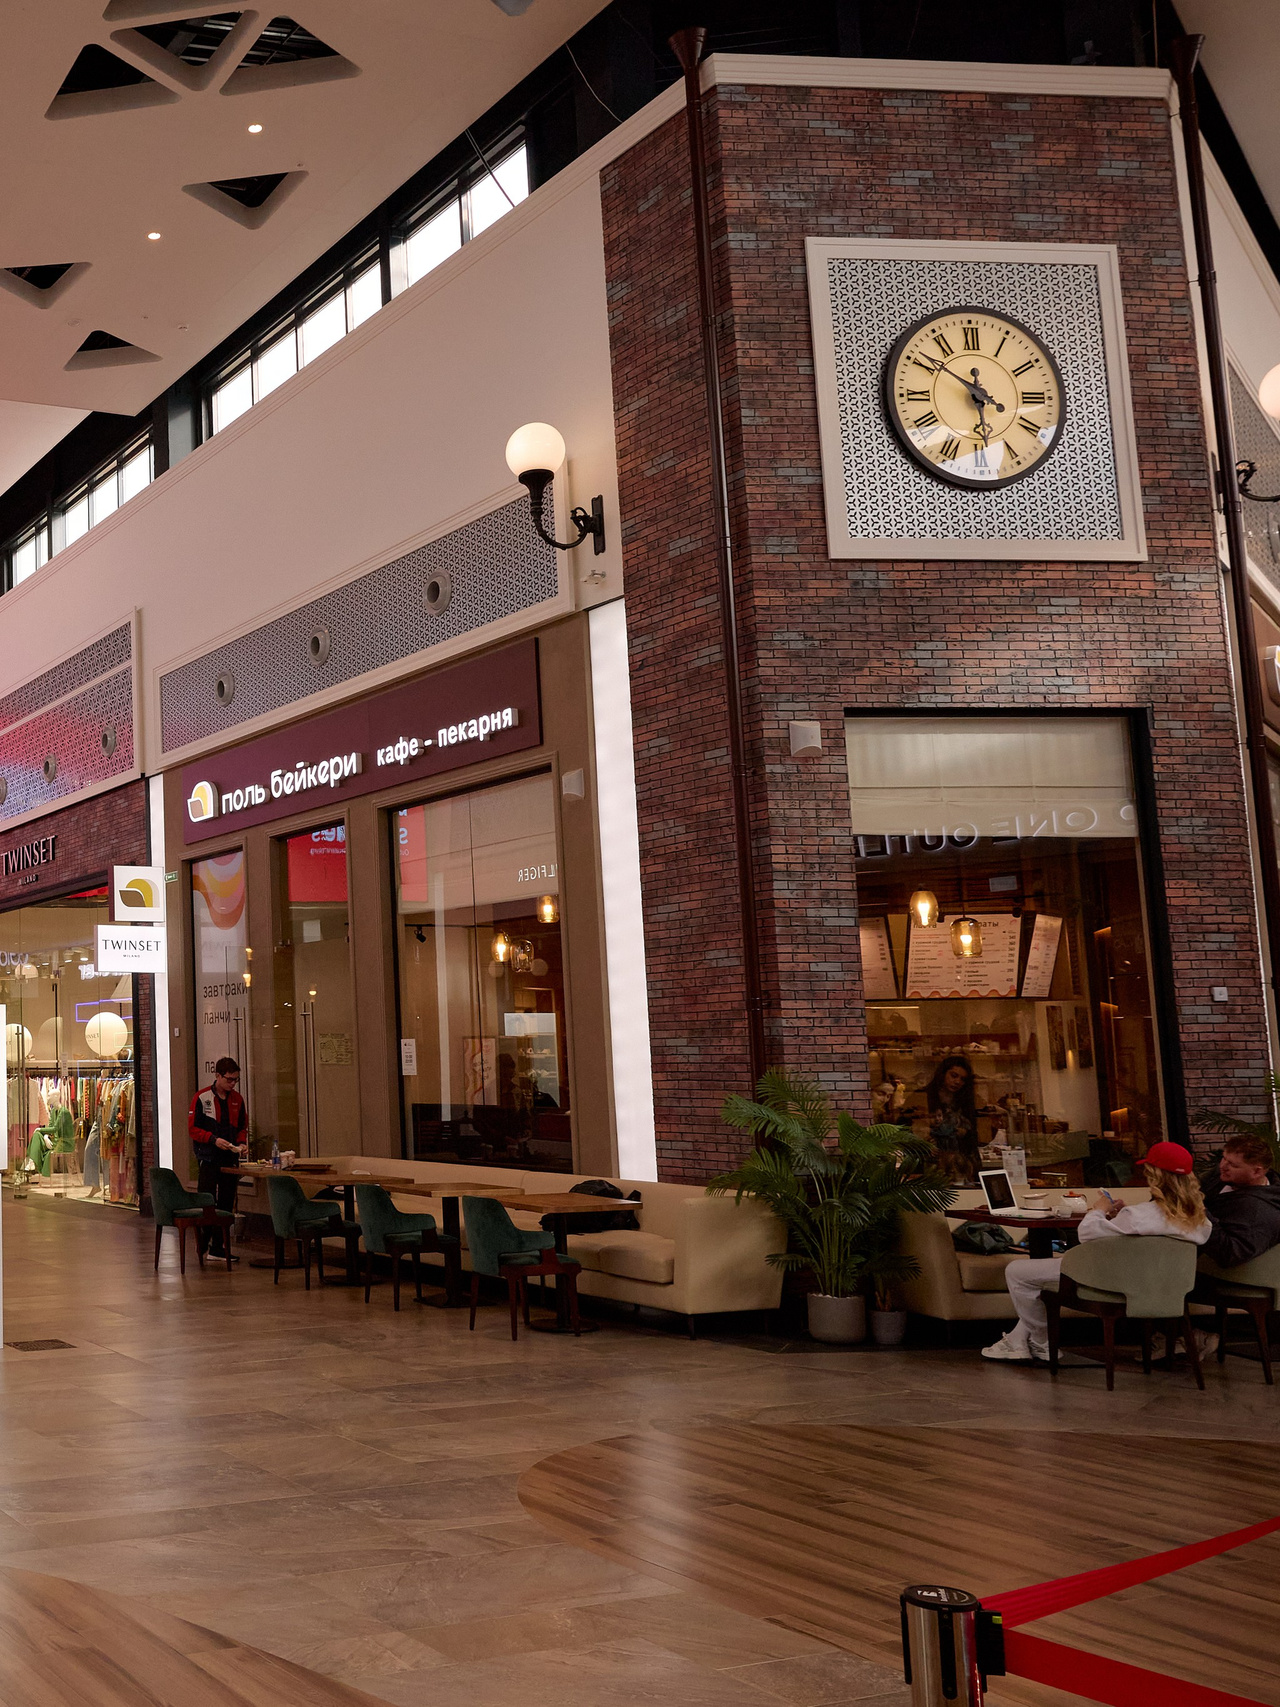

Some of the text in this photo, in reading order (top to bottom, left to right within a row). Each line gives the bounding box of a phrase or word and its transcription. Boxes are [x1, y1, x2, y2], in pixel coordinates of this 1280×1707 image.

[933, 333, 955, 358] XI
[962, 327, 981, 351] XII
[1012, 360, 1035, 377] II
[907, 389, 931, 402] IX
[1022, 391, 1045, 404] III
[376, 736, 421, 768] кафе
[436, 706, 517, 749] пекарня
[221, 752, 359, 815] поль бейкери
[1, 835, 56, 876] TWINSET
[101, 939, 162, 951] TWINSET
[203, 981, 248, 999] завтраки
[203, 1010, 231, 1025] ланчи
